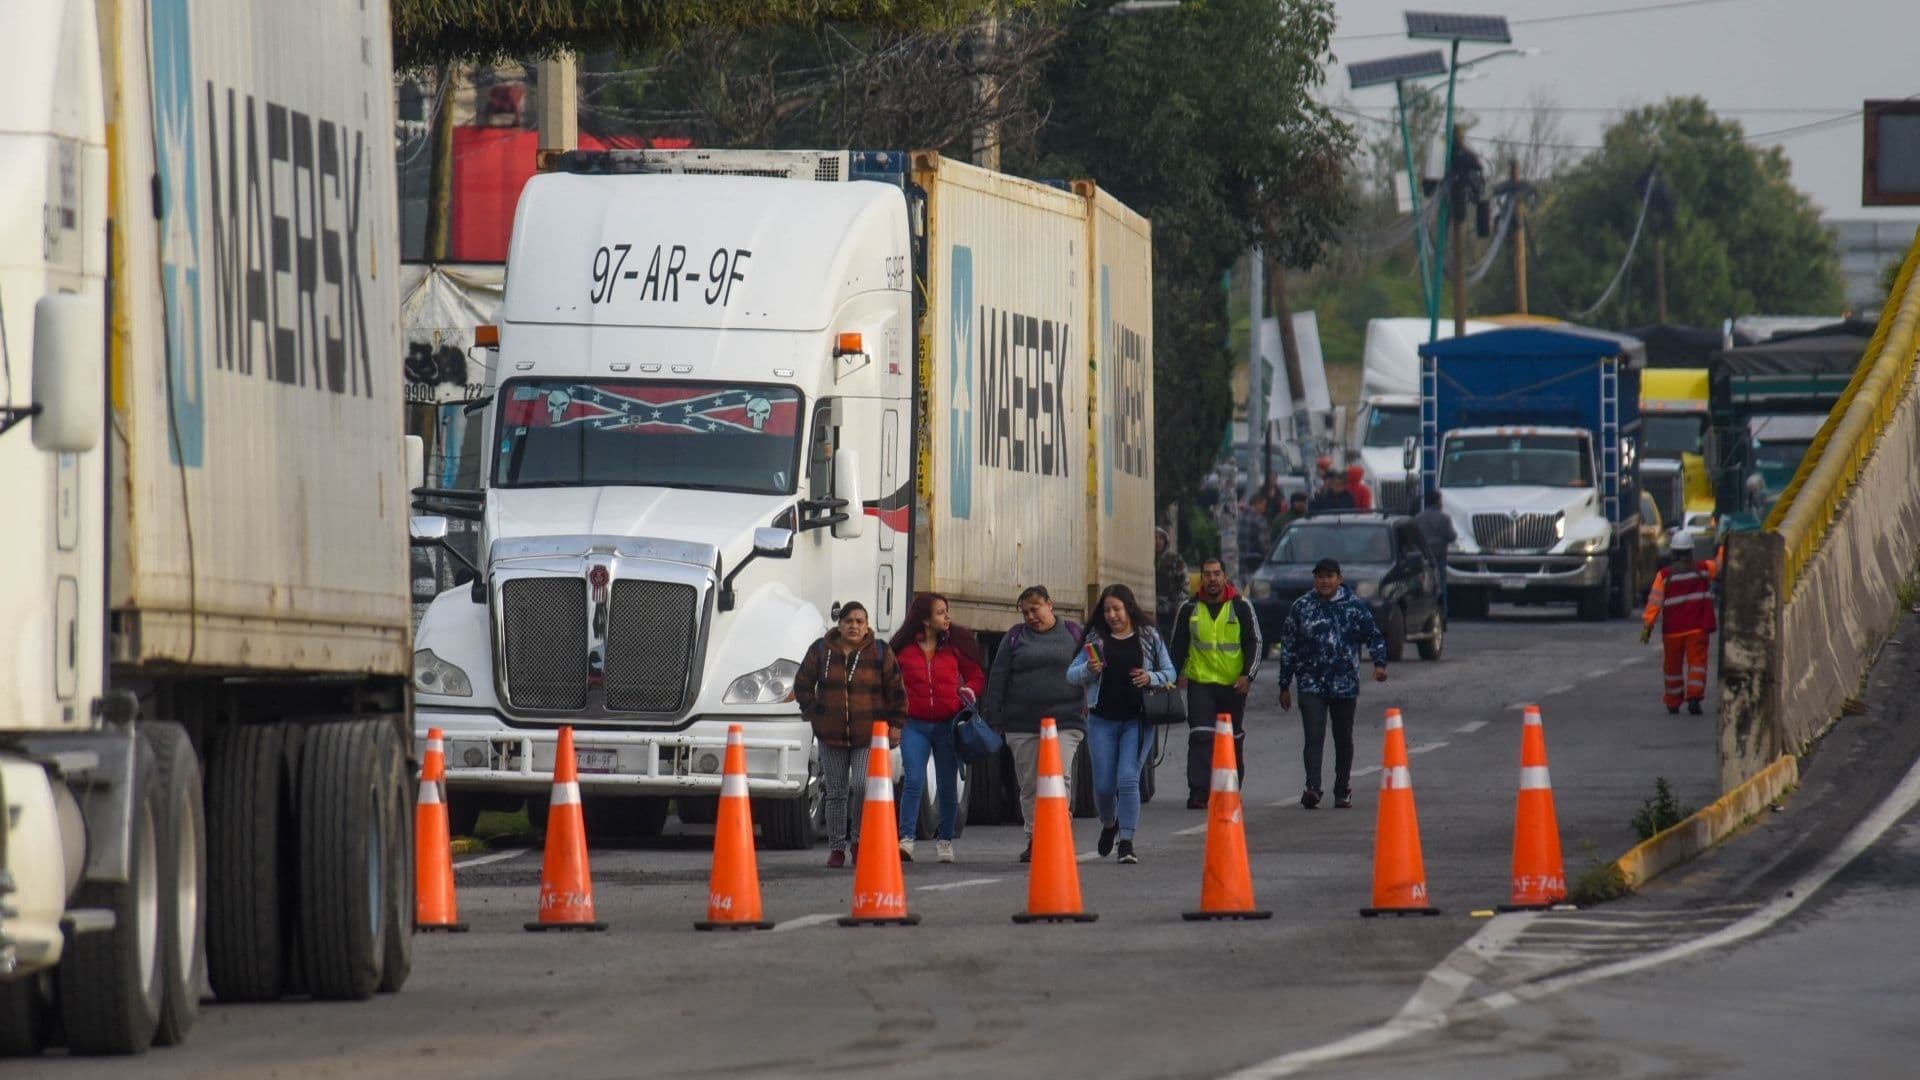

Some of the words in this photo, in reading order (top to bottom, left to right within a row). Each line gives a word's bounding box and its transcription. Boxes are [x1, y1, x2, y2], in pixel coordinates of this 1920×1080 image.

[207, 79, 373, 399] MAERSK
[590, 243, 752, 307] 97-AR-9F
[979, 304, 1069, 478] MAERSK
[1112, 319, 1148, 481] MAERSK
